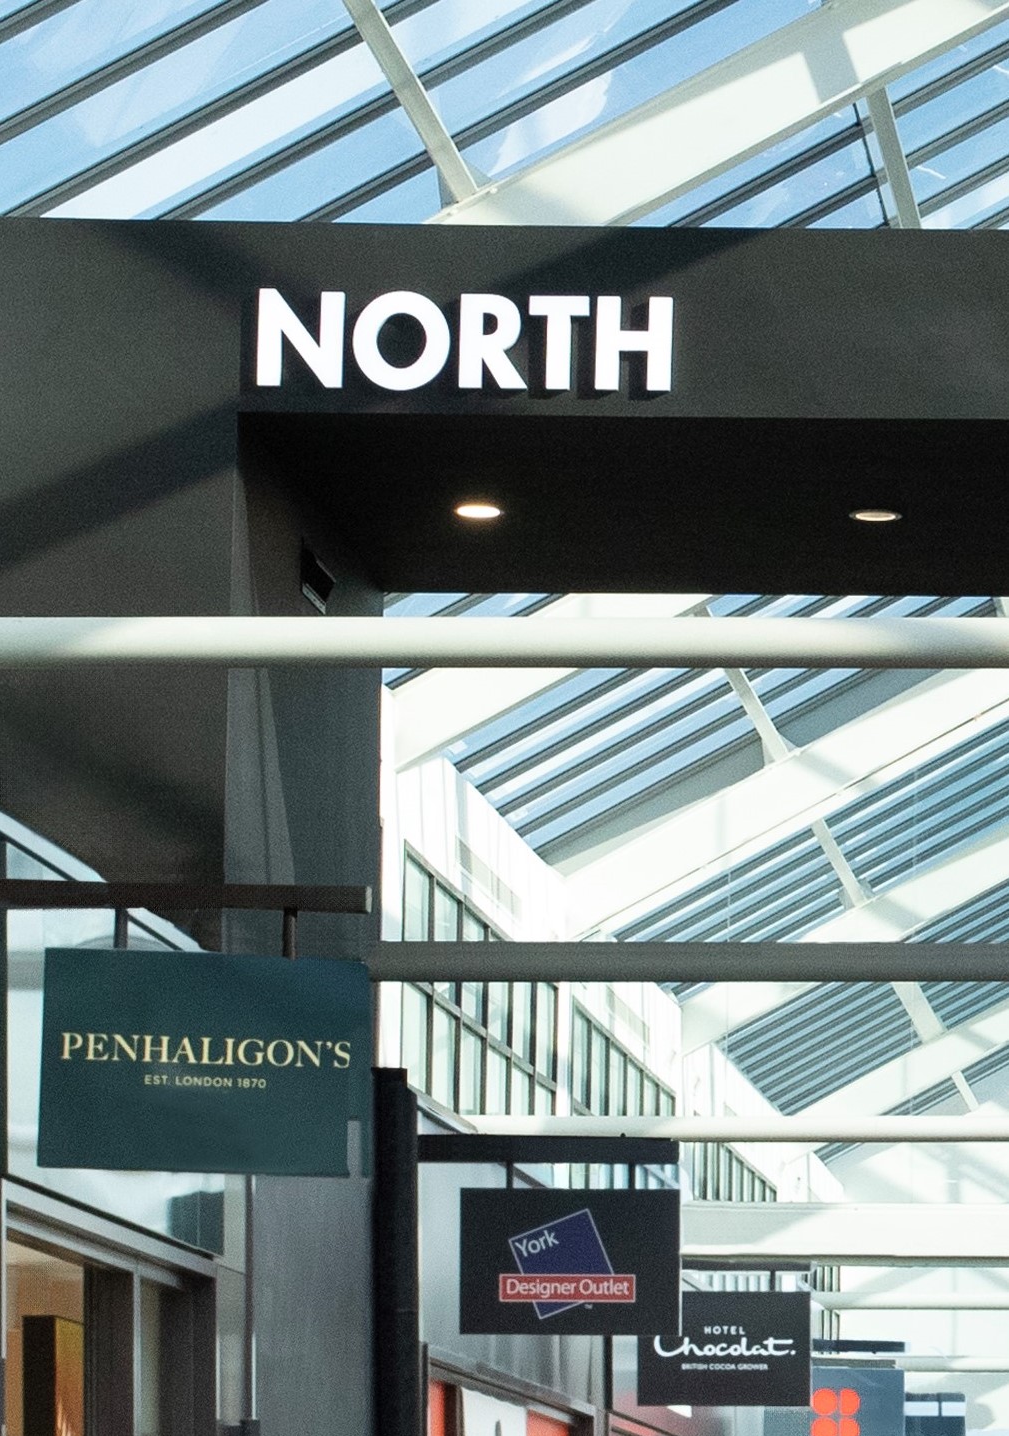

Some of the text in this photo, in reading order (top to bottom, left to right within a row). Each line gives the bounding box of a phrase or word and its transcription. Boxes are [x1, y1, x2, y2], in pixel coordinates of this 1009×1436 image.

[256, 287, 675, 392] NORTH
[61, 1032, 352, 1069] PENHALIGON'S
[175, 1075, 233, 1088] LONDON
[237, 1077, 267, 1090] 1870
[515, 1229, 560, 1258] York
[505, 1279, 630, 1298] Designer Outlet
[703, 1325, 746, 1336] HOTEL
